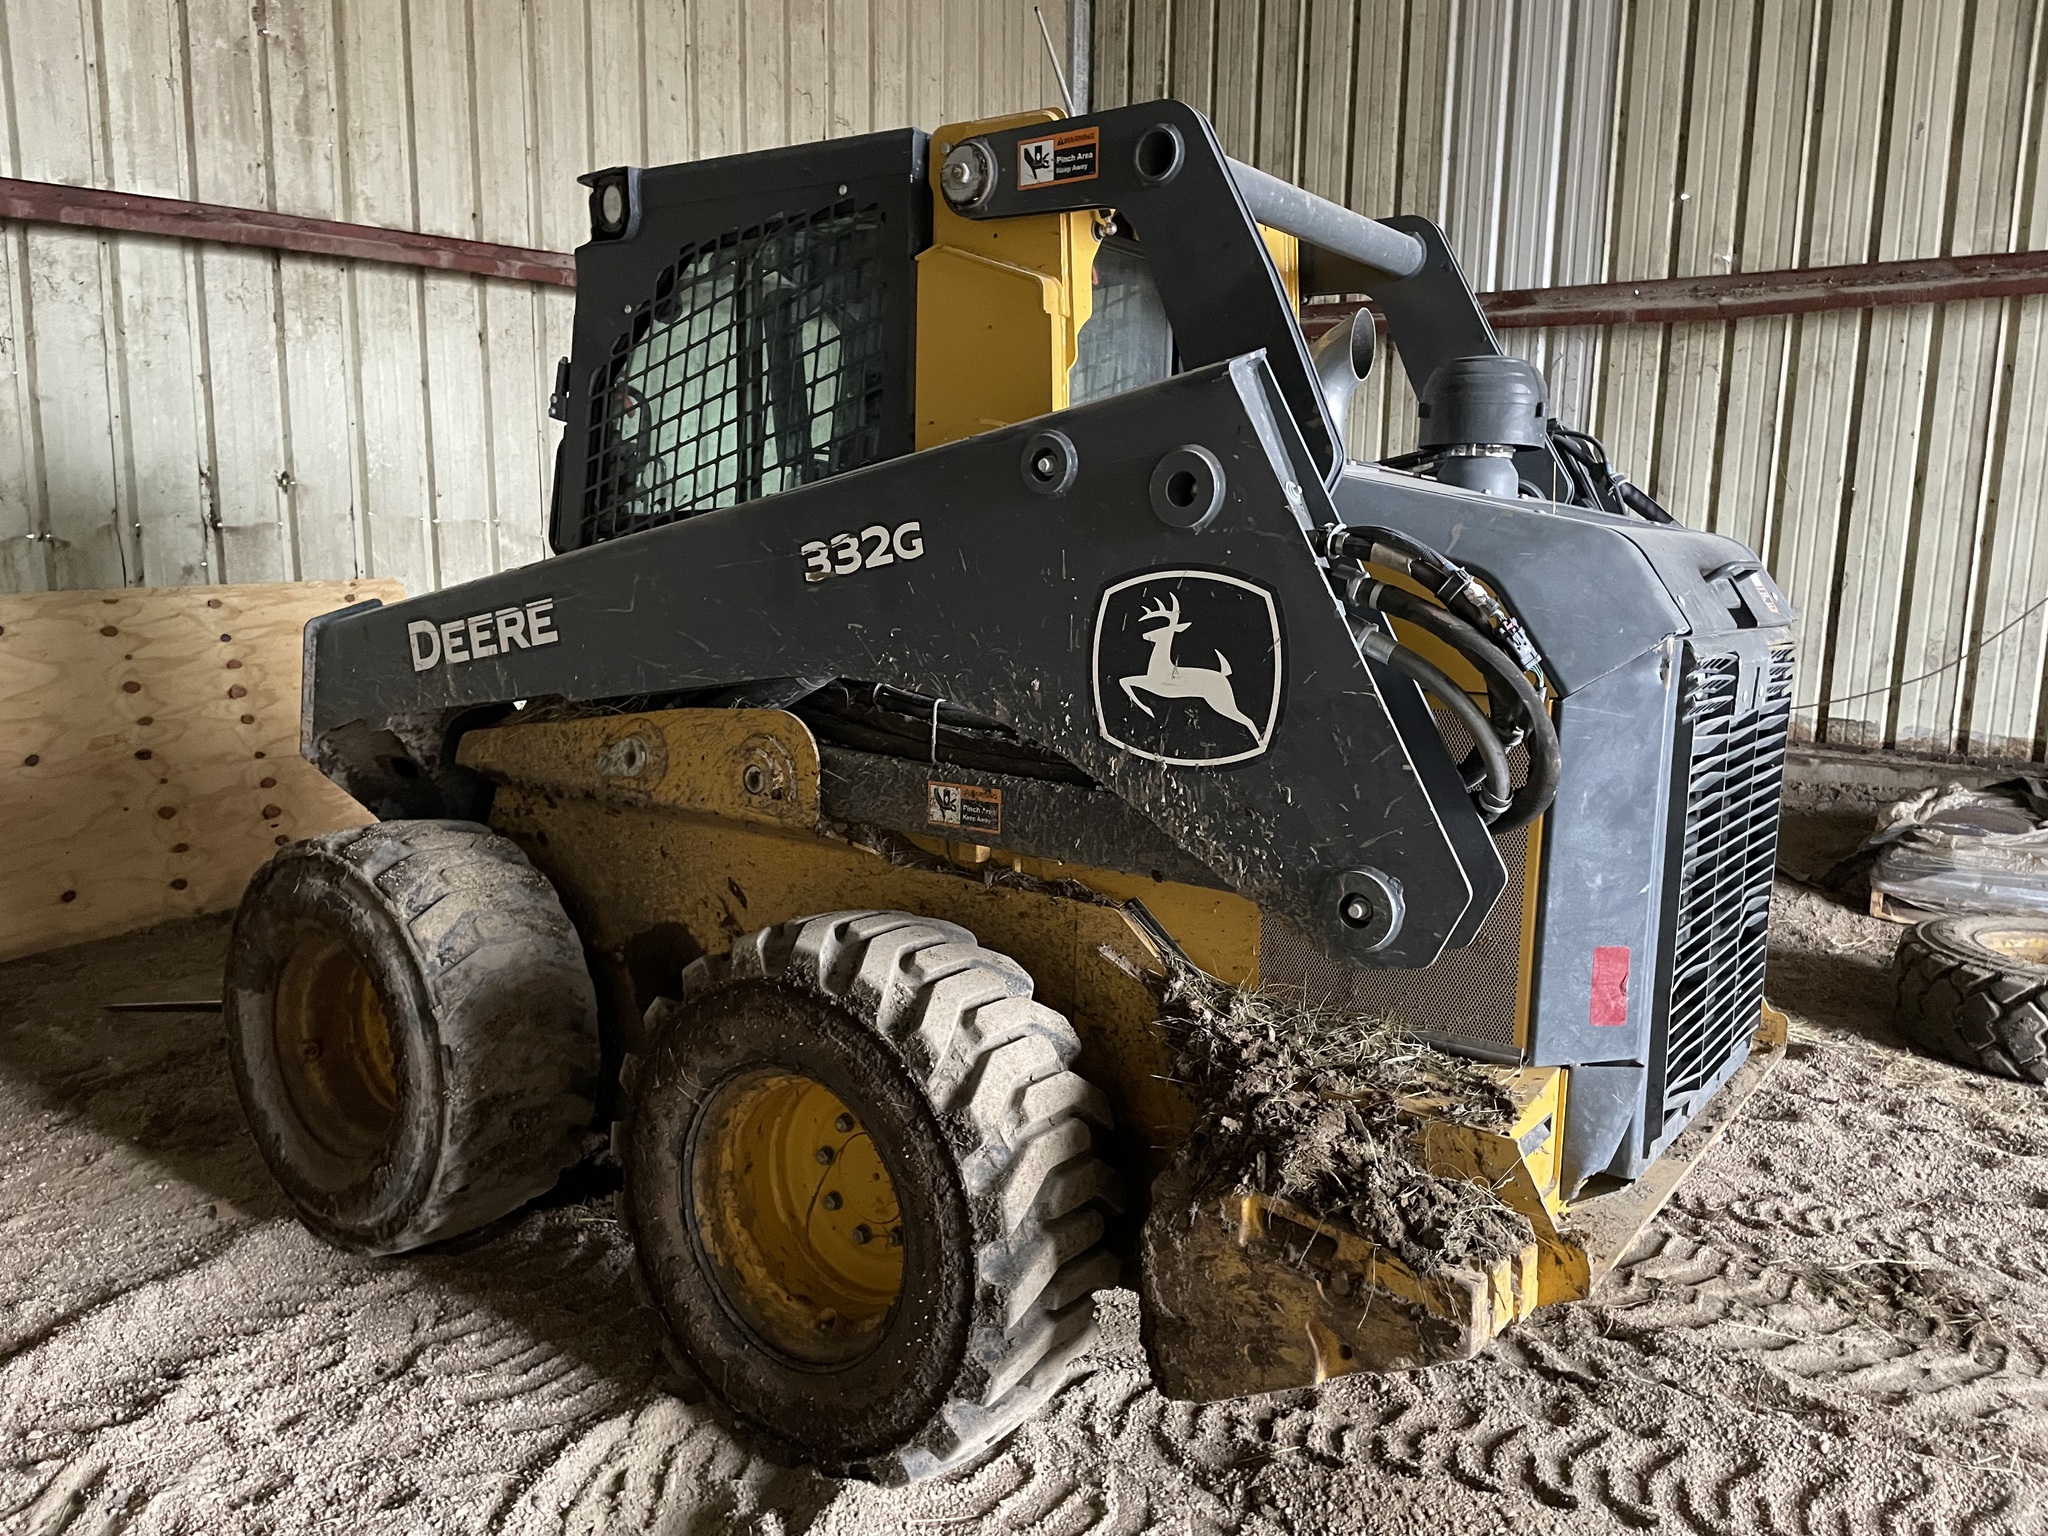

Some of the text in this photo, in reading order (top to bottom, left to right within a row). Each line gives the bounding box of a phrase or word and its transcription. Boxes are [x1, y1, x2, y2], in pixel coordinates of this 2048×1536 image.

[1064, 133, 1094, 143] WARNING
[1056, 152, 1093, 164] Pinch Area
[1072, 163, 1088, 171] Away
[801, 521, 924, 582] 332G
[408, 598, 559, 672] DEERE
[962, 804, 981, 813] Pinch
[976, 816, 991, 824] Away
